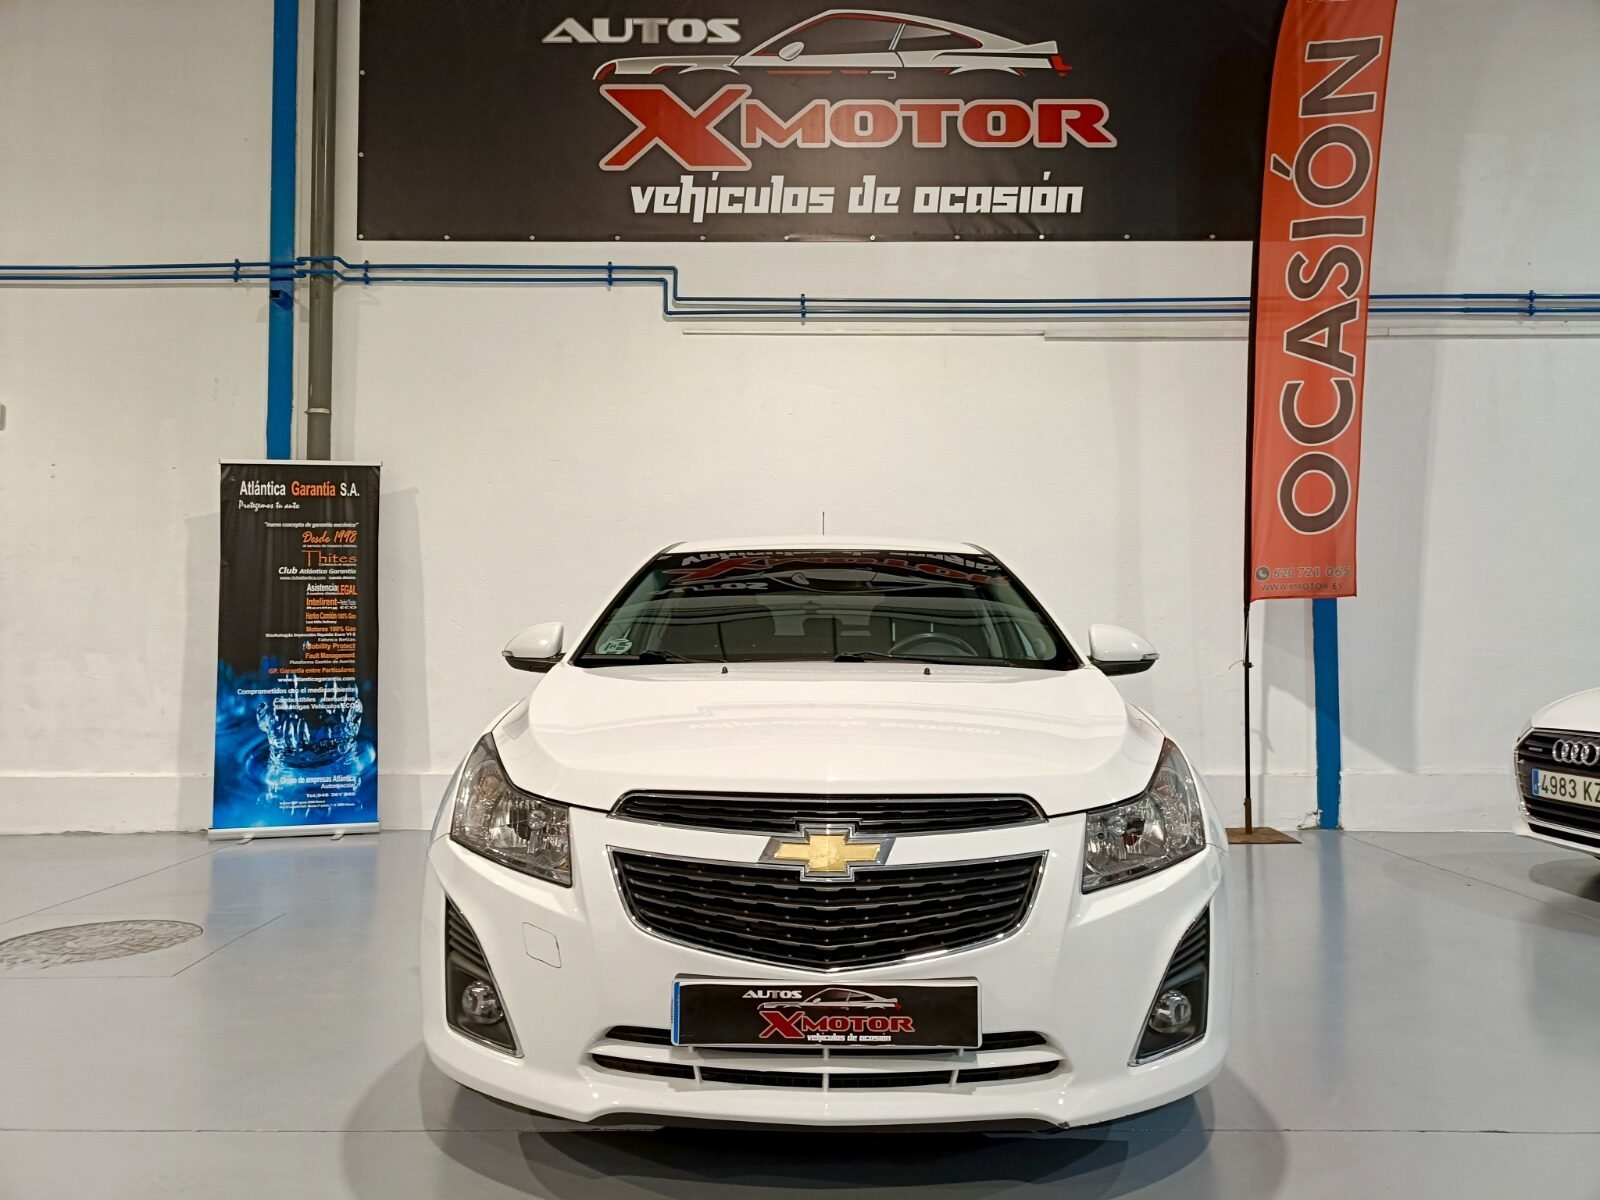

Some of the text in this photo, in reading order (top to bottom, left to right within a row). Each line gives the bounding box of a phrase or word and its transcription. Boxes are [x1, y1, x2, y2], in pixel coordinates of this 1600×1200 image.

[542, 17, 741, 44] AUTOS
[599, 84, 1118, 171] XMOTOR
[630, 171, 1084, 223] vehículos de ocasión
[1271, 35, 1384, 536] OCASIÓN
[240, 480, 360, 496] Atlántica Garantía S.A.
[302, 530, 358, 543] Desde 1998
[278, 567, 298, 575] Club
[1273, 565, 1350, 578] 620 721 065
[1541, 774, 1577, 798] 4983
[742, 990, 803, 999] AUTOS
[759, 1011, 915, 1039] XMOTOR
[847, 1033, 858, 1042] de
